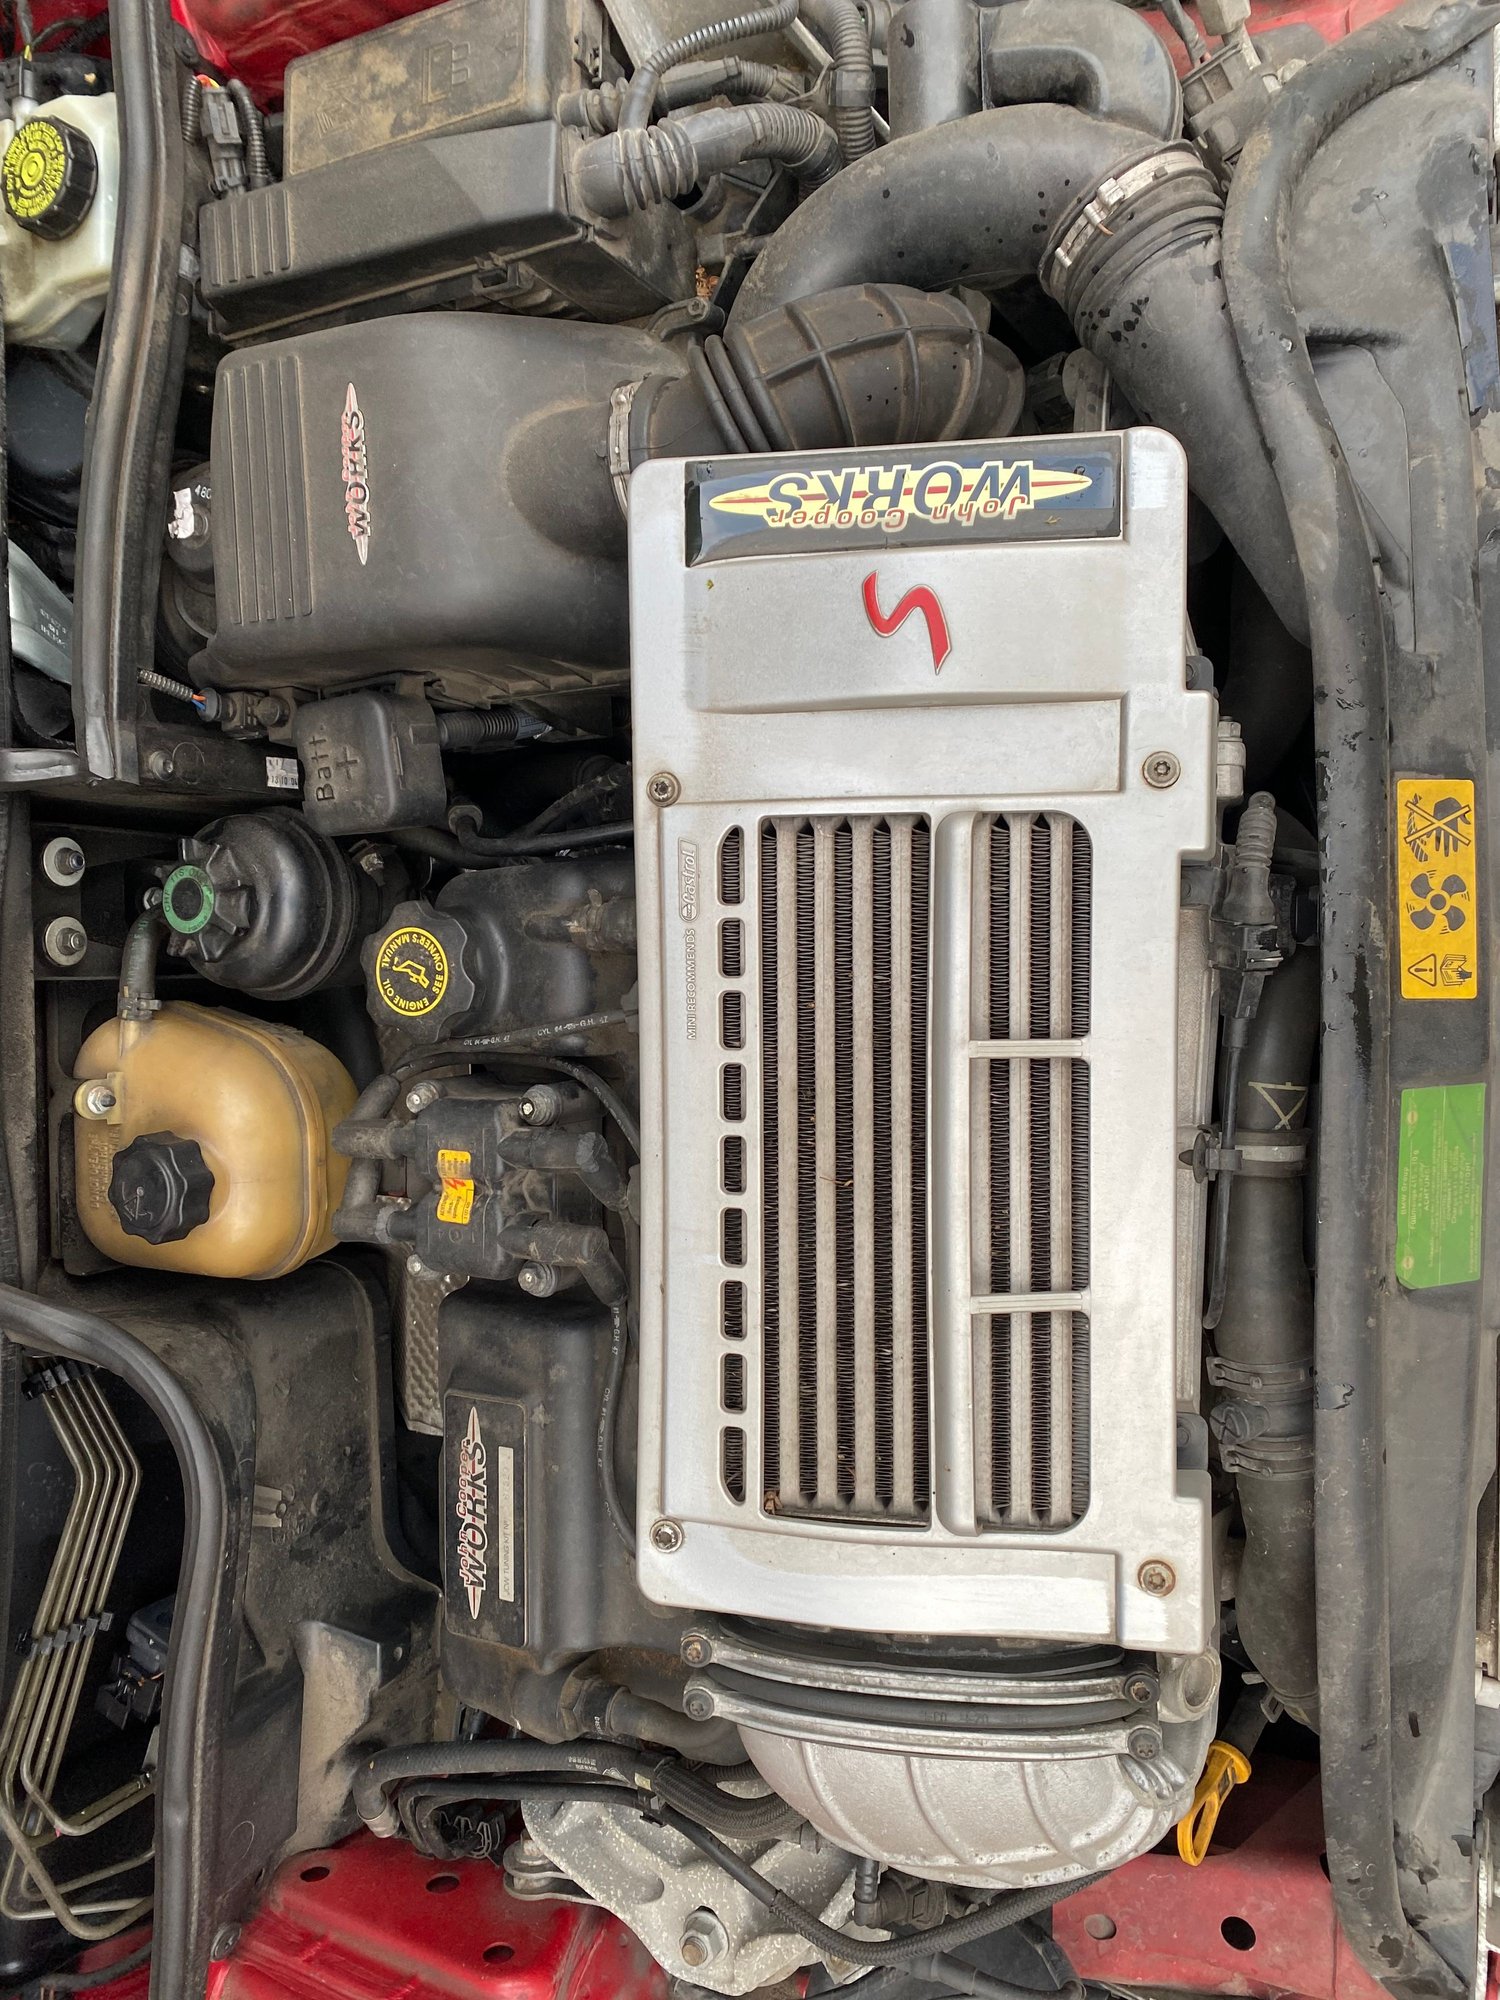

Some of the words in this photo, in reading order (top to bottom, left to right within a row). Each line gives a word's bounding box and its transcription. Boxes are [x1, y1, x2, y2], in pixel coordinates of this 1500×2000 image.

[345, 410, 369, 537] WORKS
[766, 462, 1032, 518] WORKS
[769, 504, 907, 533] Cooper
[931, 494, 1027, 527] John
[681, 849, 696, 904] Castrol
[381, 933, 410, 968] MANUAL
[411, 933, 444, 971] OWNER'S
[685, 928, 697, 1011] RECOMMENDS
[382, 978, 394, 997] OIL
[431, 973, 444, 995] SEE
[393, 994, 430, 1011] ENGINE
[537, 1027, 552, 1036] CYL
[686, 1013, 697, 1041] MINI
[88, 1152, 99, 1175] OPEN
[88, 1178, 99, 1194] NOT
[1401, 1166, 1410, 1192] Group
[1401, 1194, 1409, 1215] BMW
[454, 1438, 469, 1518] Cooper
[463, 1439, 488, 1591] WORKS
[503, 1531, 511, 1545] KIT
[456, 1530, 470, 1583] John
[503, 1577, 511, 1596] JCW
